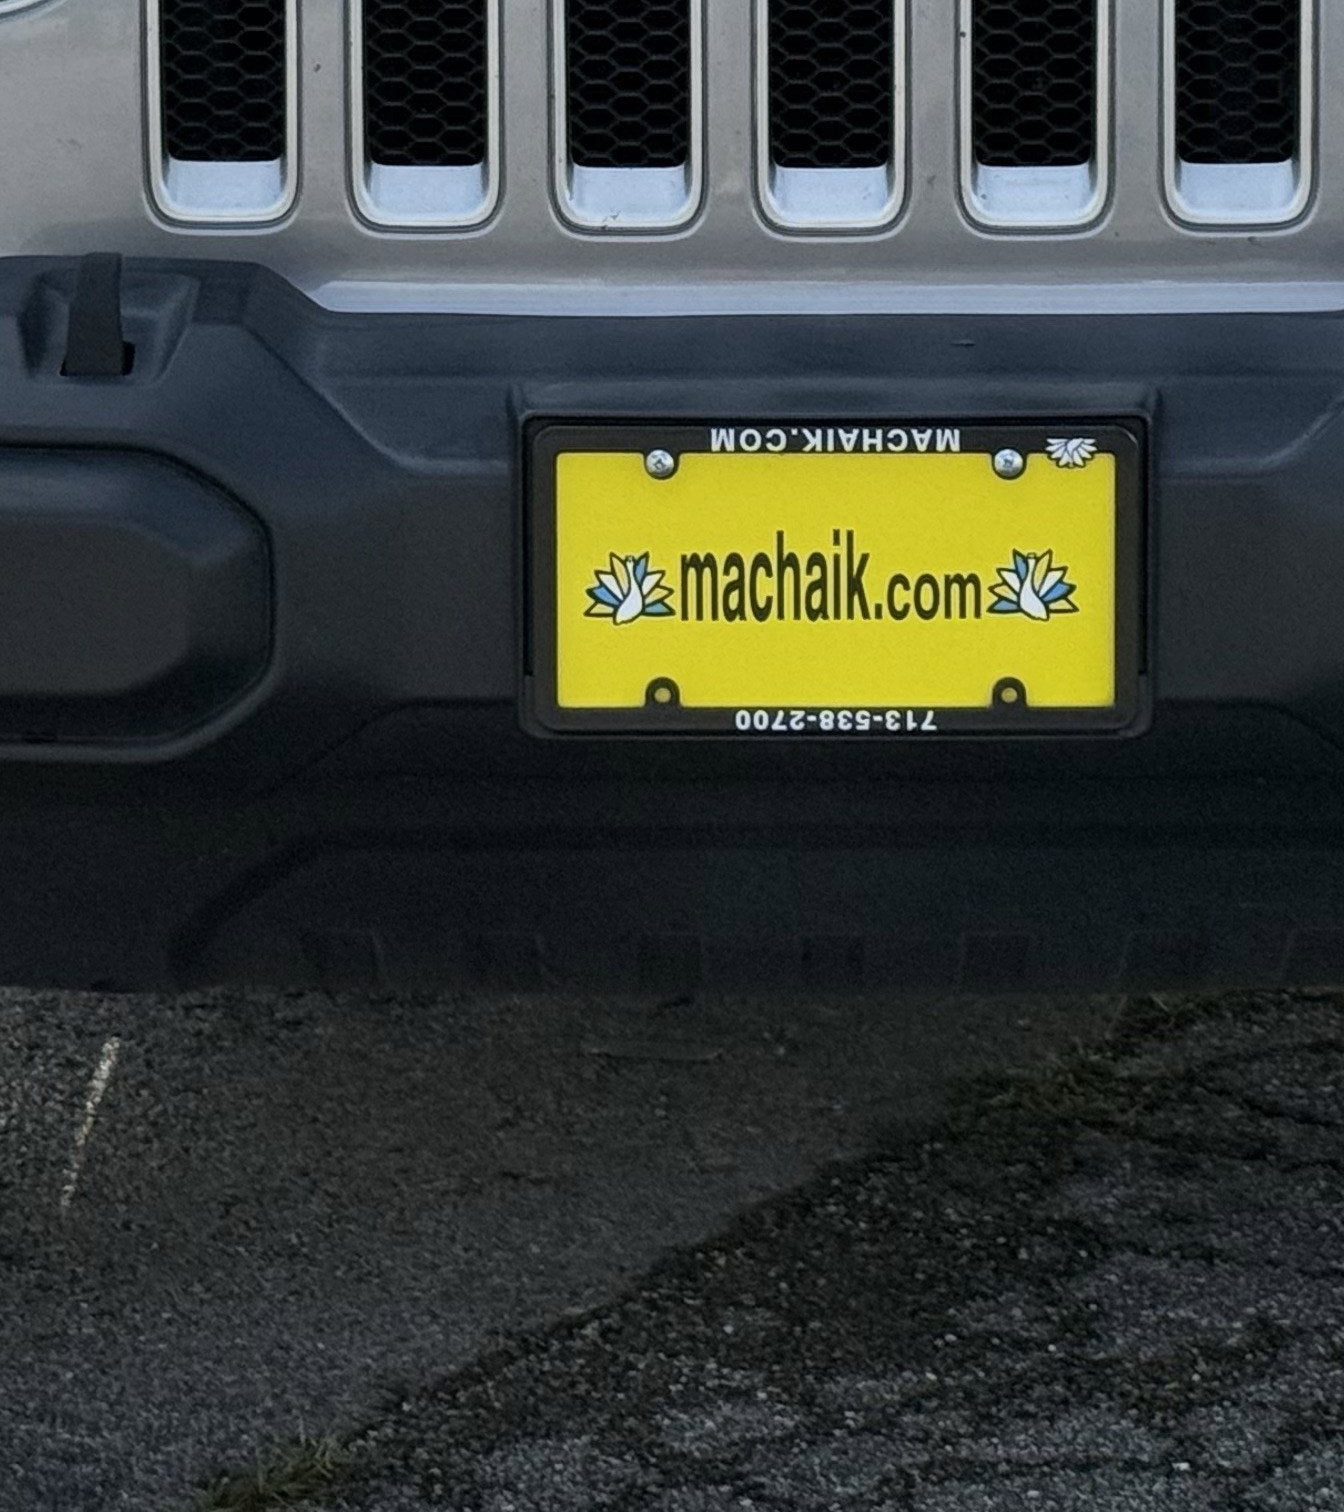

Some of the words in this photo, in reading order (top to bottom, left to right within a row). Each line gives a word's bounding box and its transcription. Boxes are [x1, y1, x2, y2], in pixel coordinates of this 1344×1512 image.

[710, 428, 962, 452] MACHAIK.COM
[679, 529, 983, 622] machaik.com
[734, 710, 939, 731] 713-538-2700
